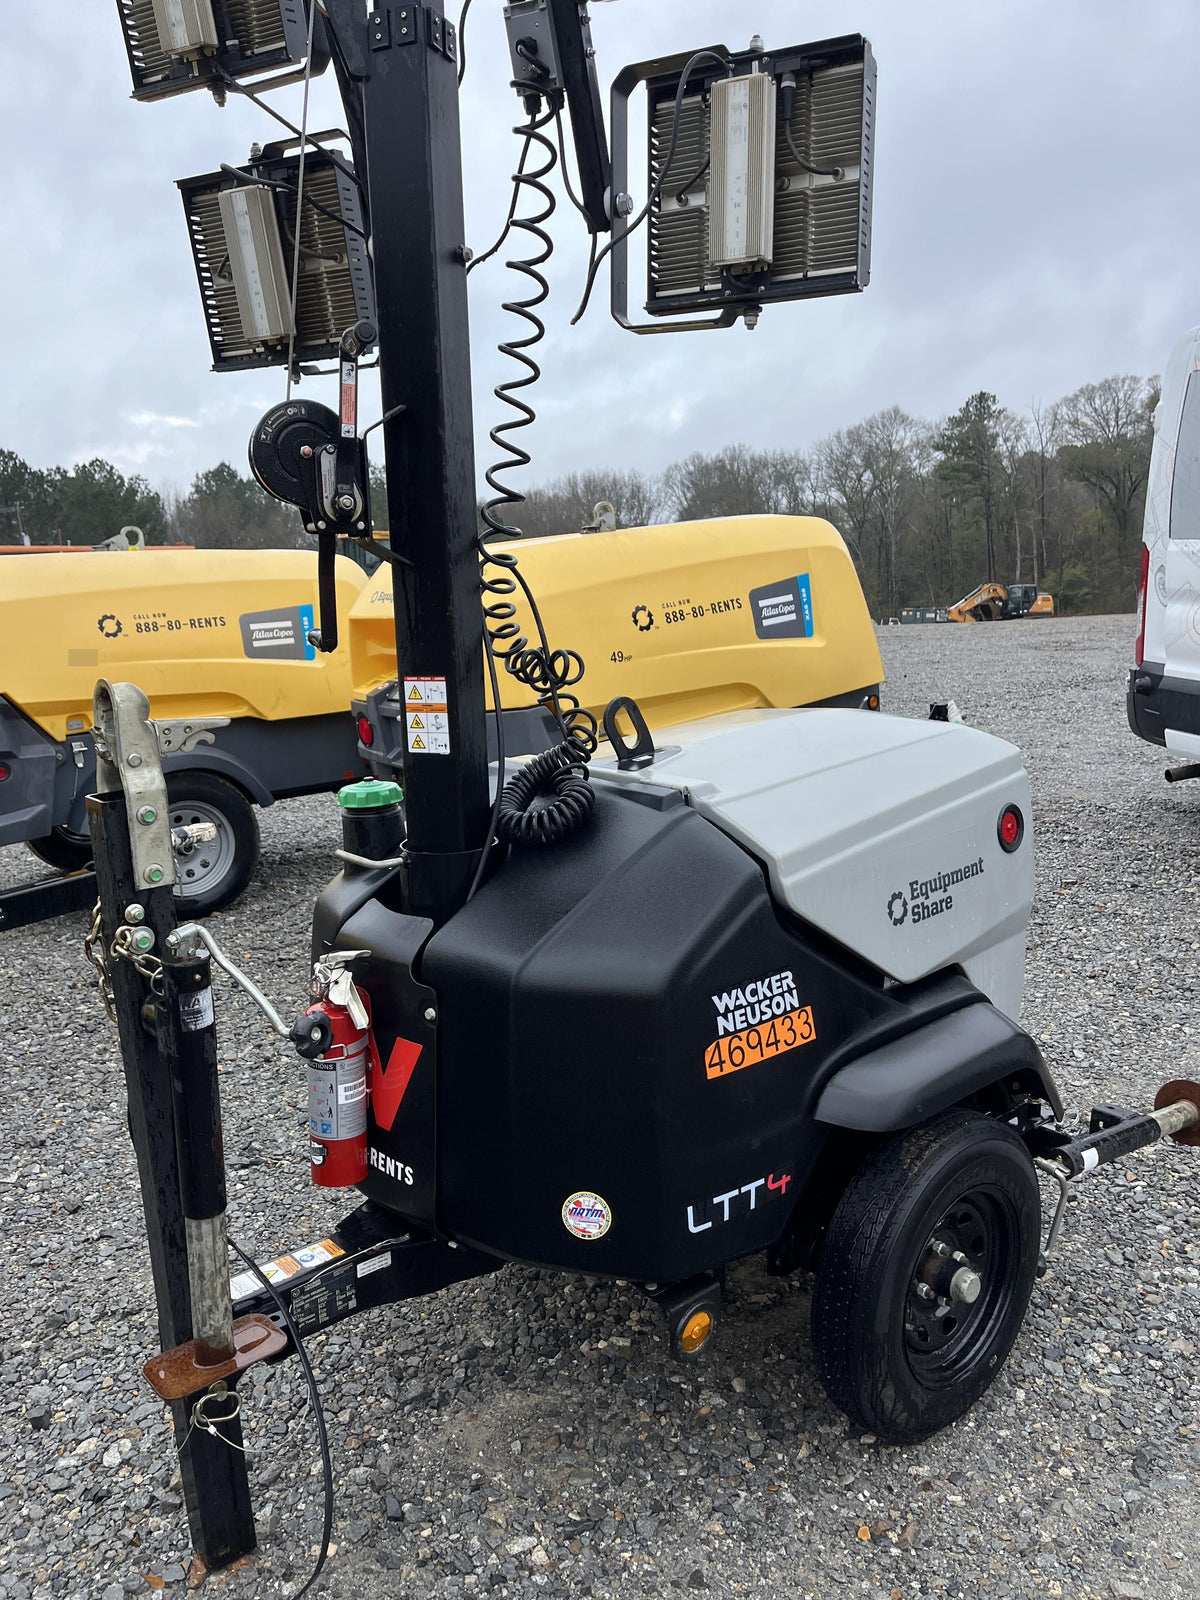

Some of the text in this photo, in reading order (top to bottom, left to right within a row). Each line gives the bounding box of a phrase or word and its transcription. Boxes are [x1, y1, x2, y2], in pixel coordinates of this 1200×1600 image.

[135, 616, 227, 634] 888-80-RENTS
[661, 598, 691, 609] CALL NOW
[664, 597, 743, 624] 888-80-RENTS
[909, 857, 984, 901] Equipment
[911, 895, 953, 924] Share
[711, 970, 796, 1014] WACKER
[716, 988, 800, 1036] NEUSON
[708, 1008, 813, 1073] 469433
[687, 1173, 791, 1234] LTT4
